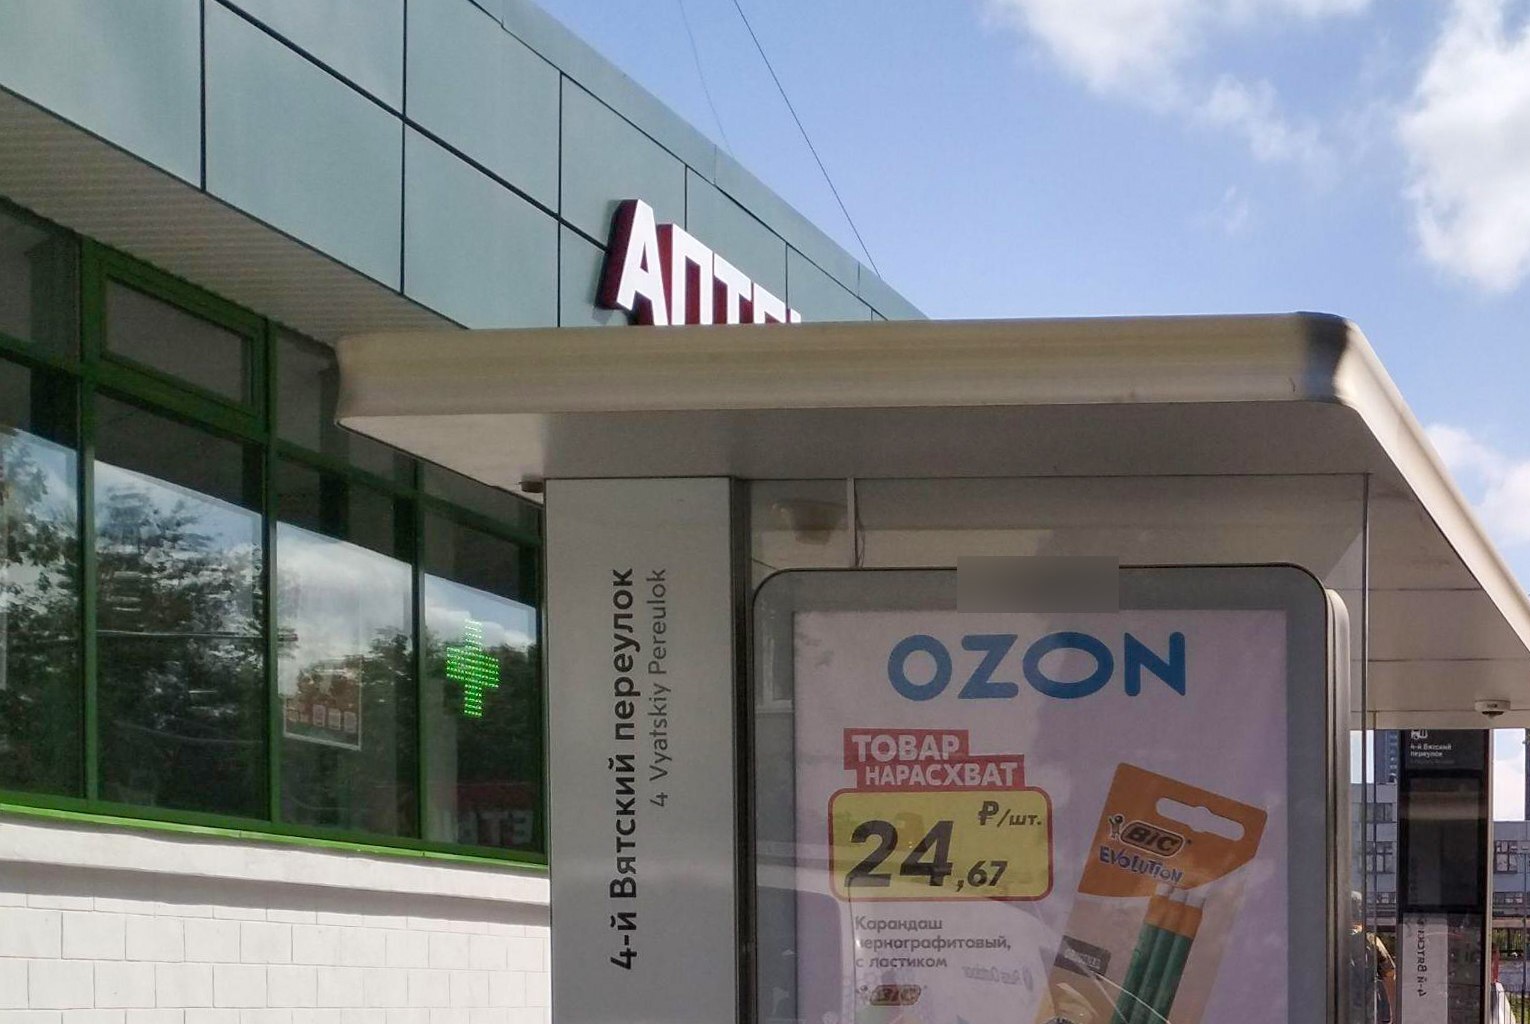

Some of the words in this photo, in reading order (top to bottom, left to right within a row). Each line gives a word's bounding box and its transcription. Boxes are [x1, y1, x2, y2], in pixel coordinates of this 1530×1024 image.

[646, 568, 668, 675] Pereulok
[612, 568, 641, 741] переулок
[887, 631, 1186, 701] OZON
[648, 683, 673, 782] Vyatskiy
[851, 735, 960, 762] ТОВАР
[648, 791, 668, 807] 4
[865, 763, 1019, 787] НАРАСХВАТ
[608, 754, 637, 898] Вятский
[610, 912, 637, 970] 4-й
[856, 916, 943, 933] Карандаш
[869, 957, 948, 968] ластиком
